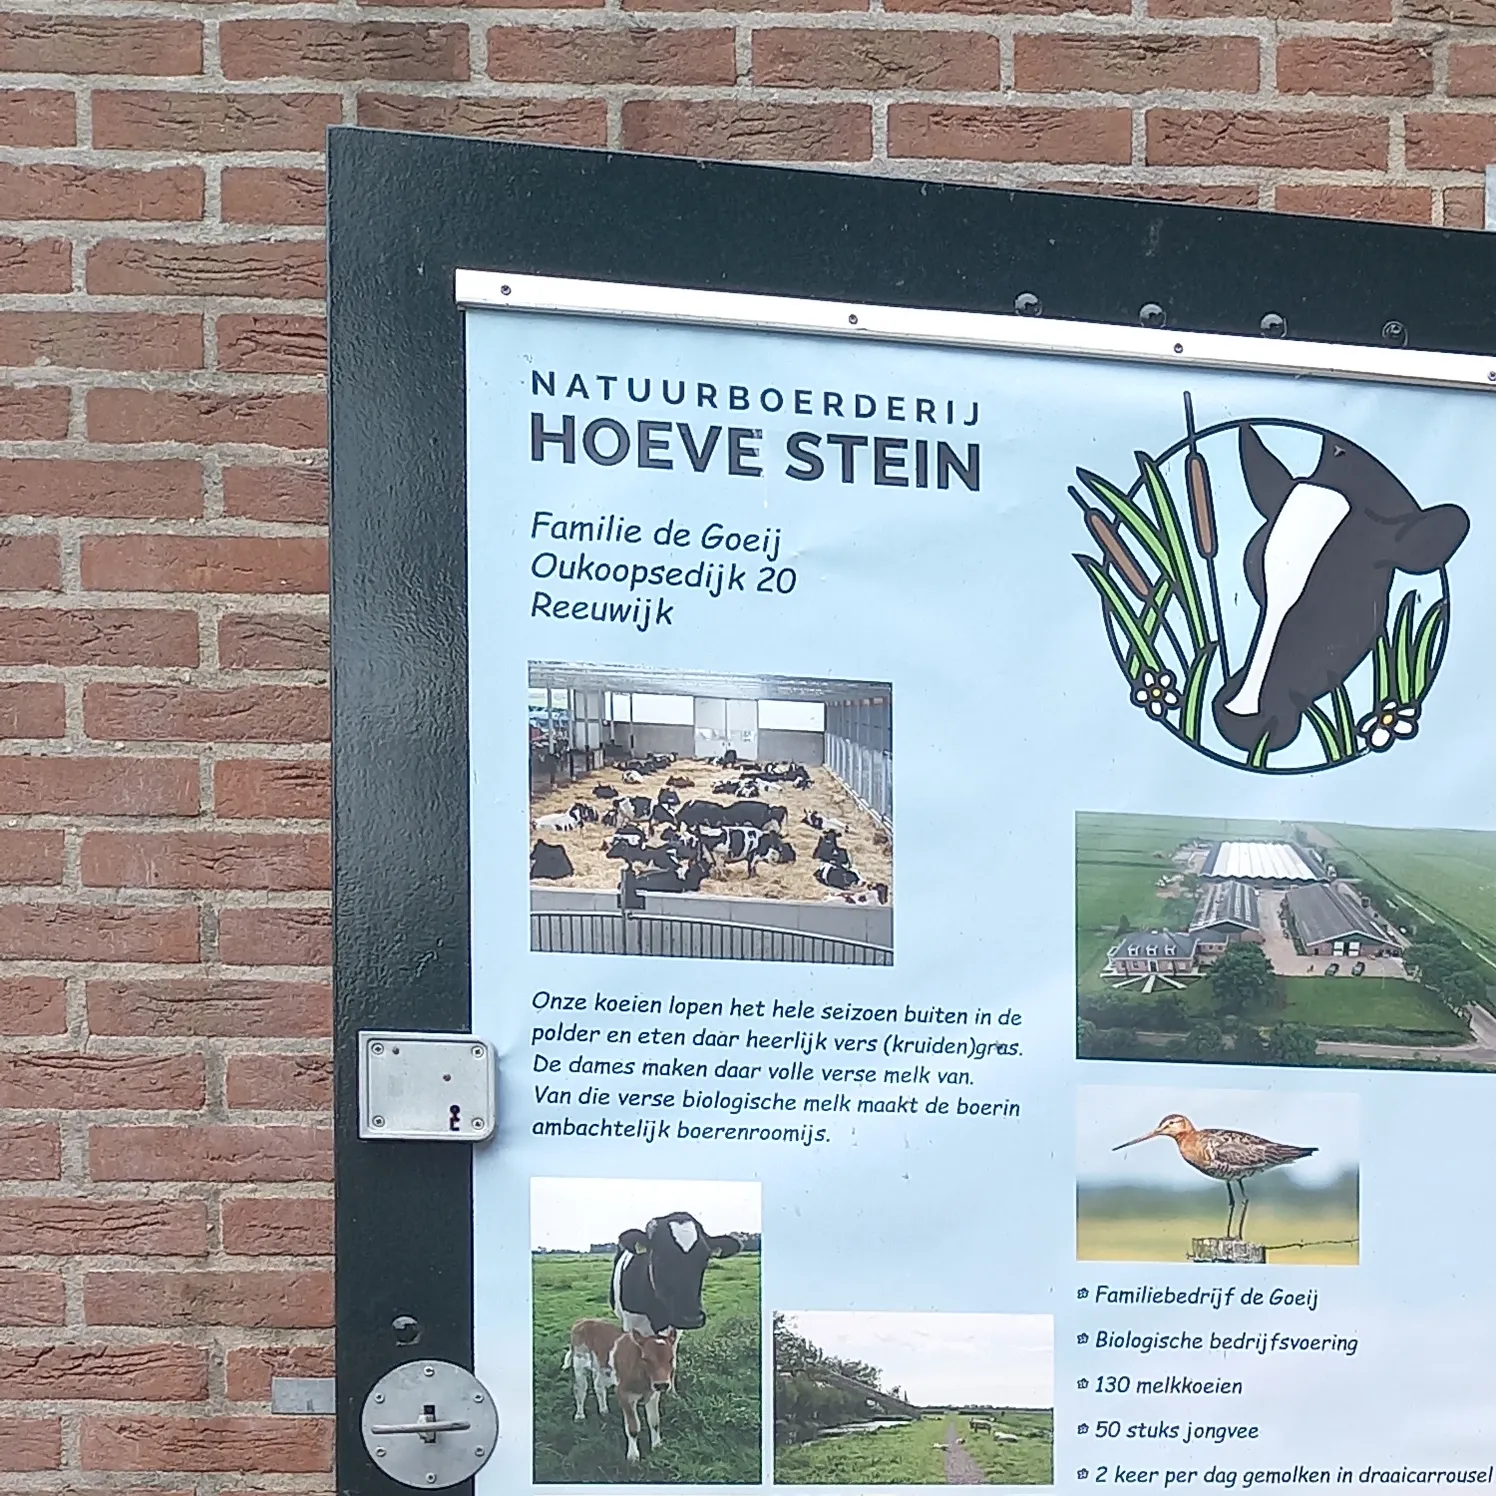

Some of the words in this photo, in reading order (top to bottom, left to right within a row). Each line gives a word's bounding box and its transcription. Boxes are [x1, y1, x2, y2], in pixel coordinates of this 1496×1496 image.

[531, 369, 979, 427] NATUURBOERDERIJ
[530, 411, 764, 478] HOEVE
[784, 431, 981, 493] STEIN
[530, 510, 642, 544] Familie
[653, 518, 691, 548] de
[700, 522, 782, 563] Goeij
[530, 551, 747, 599] Oukoopsedijk
[756, 566, 797, 595] 20
[530, 590, 674, 633] Reeuwijk
[531, 990, 588, 1014] Onze
[594, 991, 662, 1014] koeien
[668, 994, 723, 1021] lopen
[729, 997, 766, 1018] het
[772, 998, 815, 1019] hele
[820, 1002, 898, 1023] seizoen
[903, 1003, 968, 1025] buiten
[974, 1007, 992, 1026] in
[997, 1007, 1023, 1026] de
[530, 1021, 601, 1046] polder
[606, 1030, 632, 1044] en
[637, 1027, 686, 1046] eten
[692, 1027, 740, 1048] daar
[745, 1028, 828, 1056] heerlijk
[833, 1037, 879, 1052] vers
[883, 1033, 1023, 1060] (kruiden)gras.
[532, 1053, 562, 1073] De
[568, 1054, 636, 1075] dames
[641, 1057, 708, 1078] maken
[714, 1058, 762, 1080] daar
[768, 1060, 815, 1081] volle
[821, 1068, 877, 1083] verse
[883, 1065, 931, 1084] melk
[937, 1071, 974, 1086] van.
[534, 1084, 572, 1105] Van
[577, 1085, 611, 1106] die
[617, 1092, 675, 1108] verse
[682, 1089, 797, 1115] biologische
[803, 1093, 852, 1113] melk
[856, 1095, 919, 1114] maakt
[924, 1095, 950, 1115] de
[956, 1096, 1020, 1117] boerin
[531, 1116, 671, 1144] ambachtelijk
[676, 1119, 831, 1147] boerenroomijs.
[1095, 1284, 1237, 1311] Familiebedrijf
[1240, 1286, 1264, 1306] de
[1268, 1287, 1318, 1312] Goeij
[1095, 1329, 1203, 1354] Biologische
[1209, 1331, 1359, 1358] bedrijfsvoering
[1094, 1375, 1131, 1394] 130
[1136, 1375, 1243, 1395] melkkoeien
[1094, 1420, 1122, 1439] 50
[1125, 1420, 1180, 1439] stuks
[1182, 1421, 1260, 1444] jongvee
[1095, 1465, 1108, 1483] 2
[1114, 1464, 1160, 1484] keer
[1164, 1470, 1199, 1489] per
[1203, 1464, 1238, 1489] dag
[1241, 1465, 1331, 1489] gemolken
[1336, 1466, 1353, 1484] in
[1358, 1465, 1494, 1484] draaicarrousel
